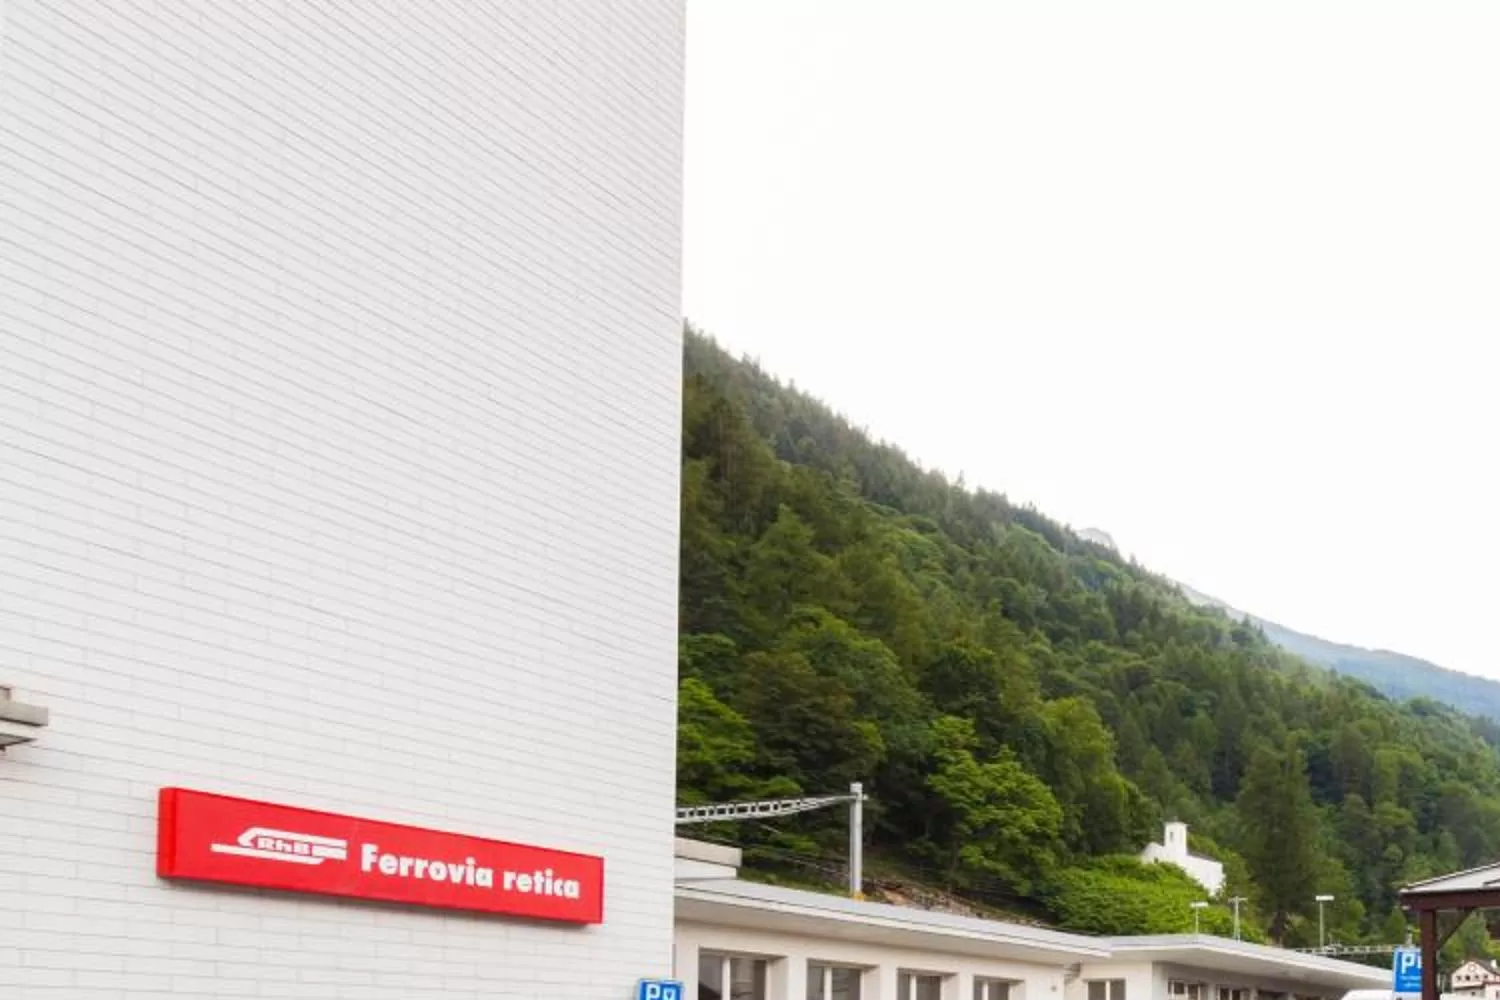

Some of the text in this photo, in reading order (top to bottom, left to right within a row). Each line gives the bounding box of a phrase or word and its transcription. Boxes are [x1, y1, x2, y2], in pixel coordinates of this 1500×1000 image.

[256, 836, 312, 857] RhB
[361, 842, 580, 899] Ferrovia retica
